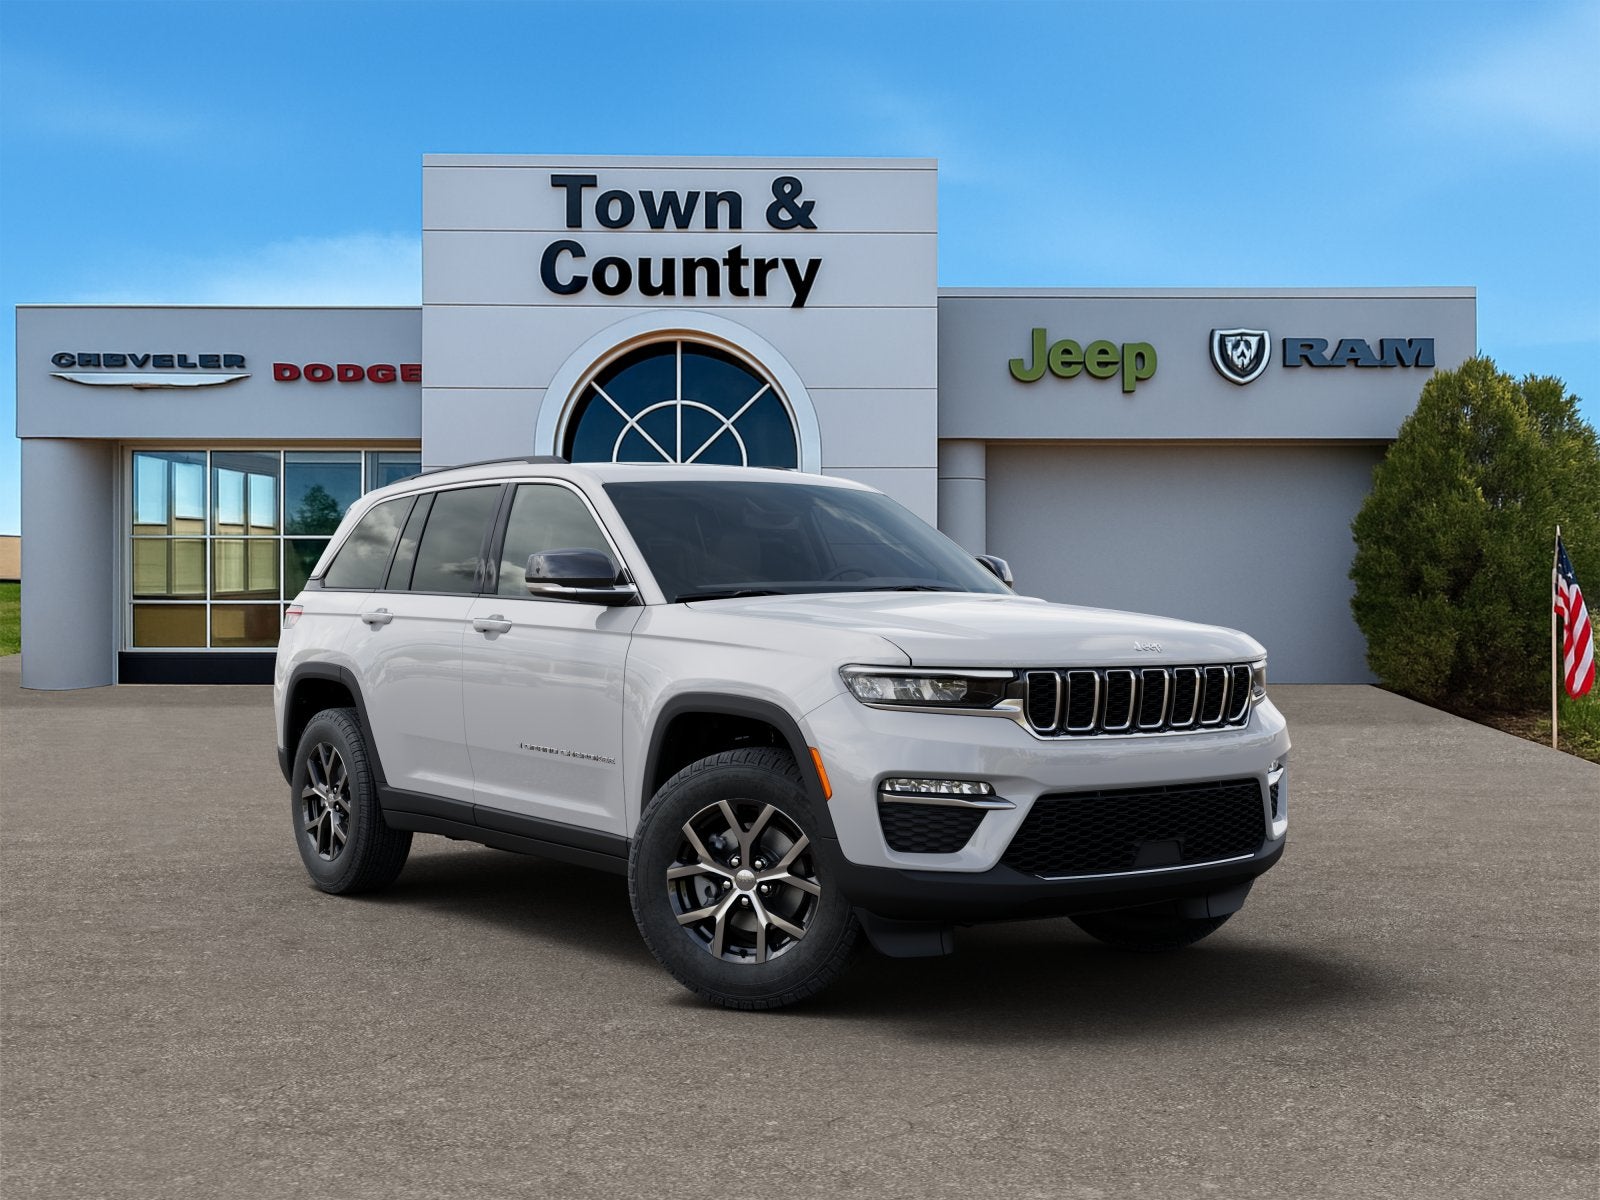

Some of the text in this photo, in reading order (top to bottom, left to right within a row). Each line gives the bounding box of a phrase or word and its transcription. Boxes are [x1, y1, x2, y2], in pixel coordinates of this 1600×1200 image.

[551, 174, 818, 230] Town &
[540, 239, 822, 308] Country
[273, 363, 422, 383] DODGE
[1009, 328, 1157, 393] Jeep
[1282, 337, 1435, 368] RAM
